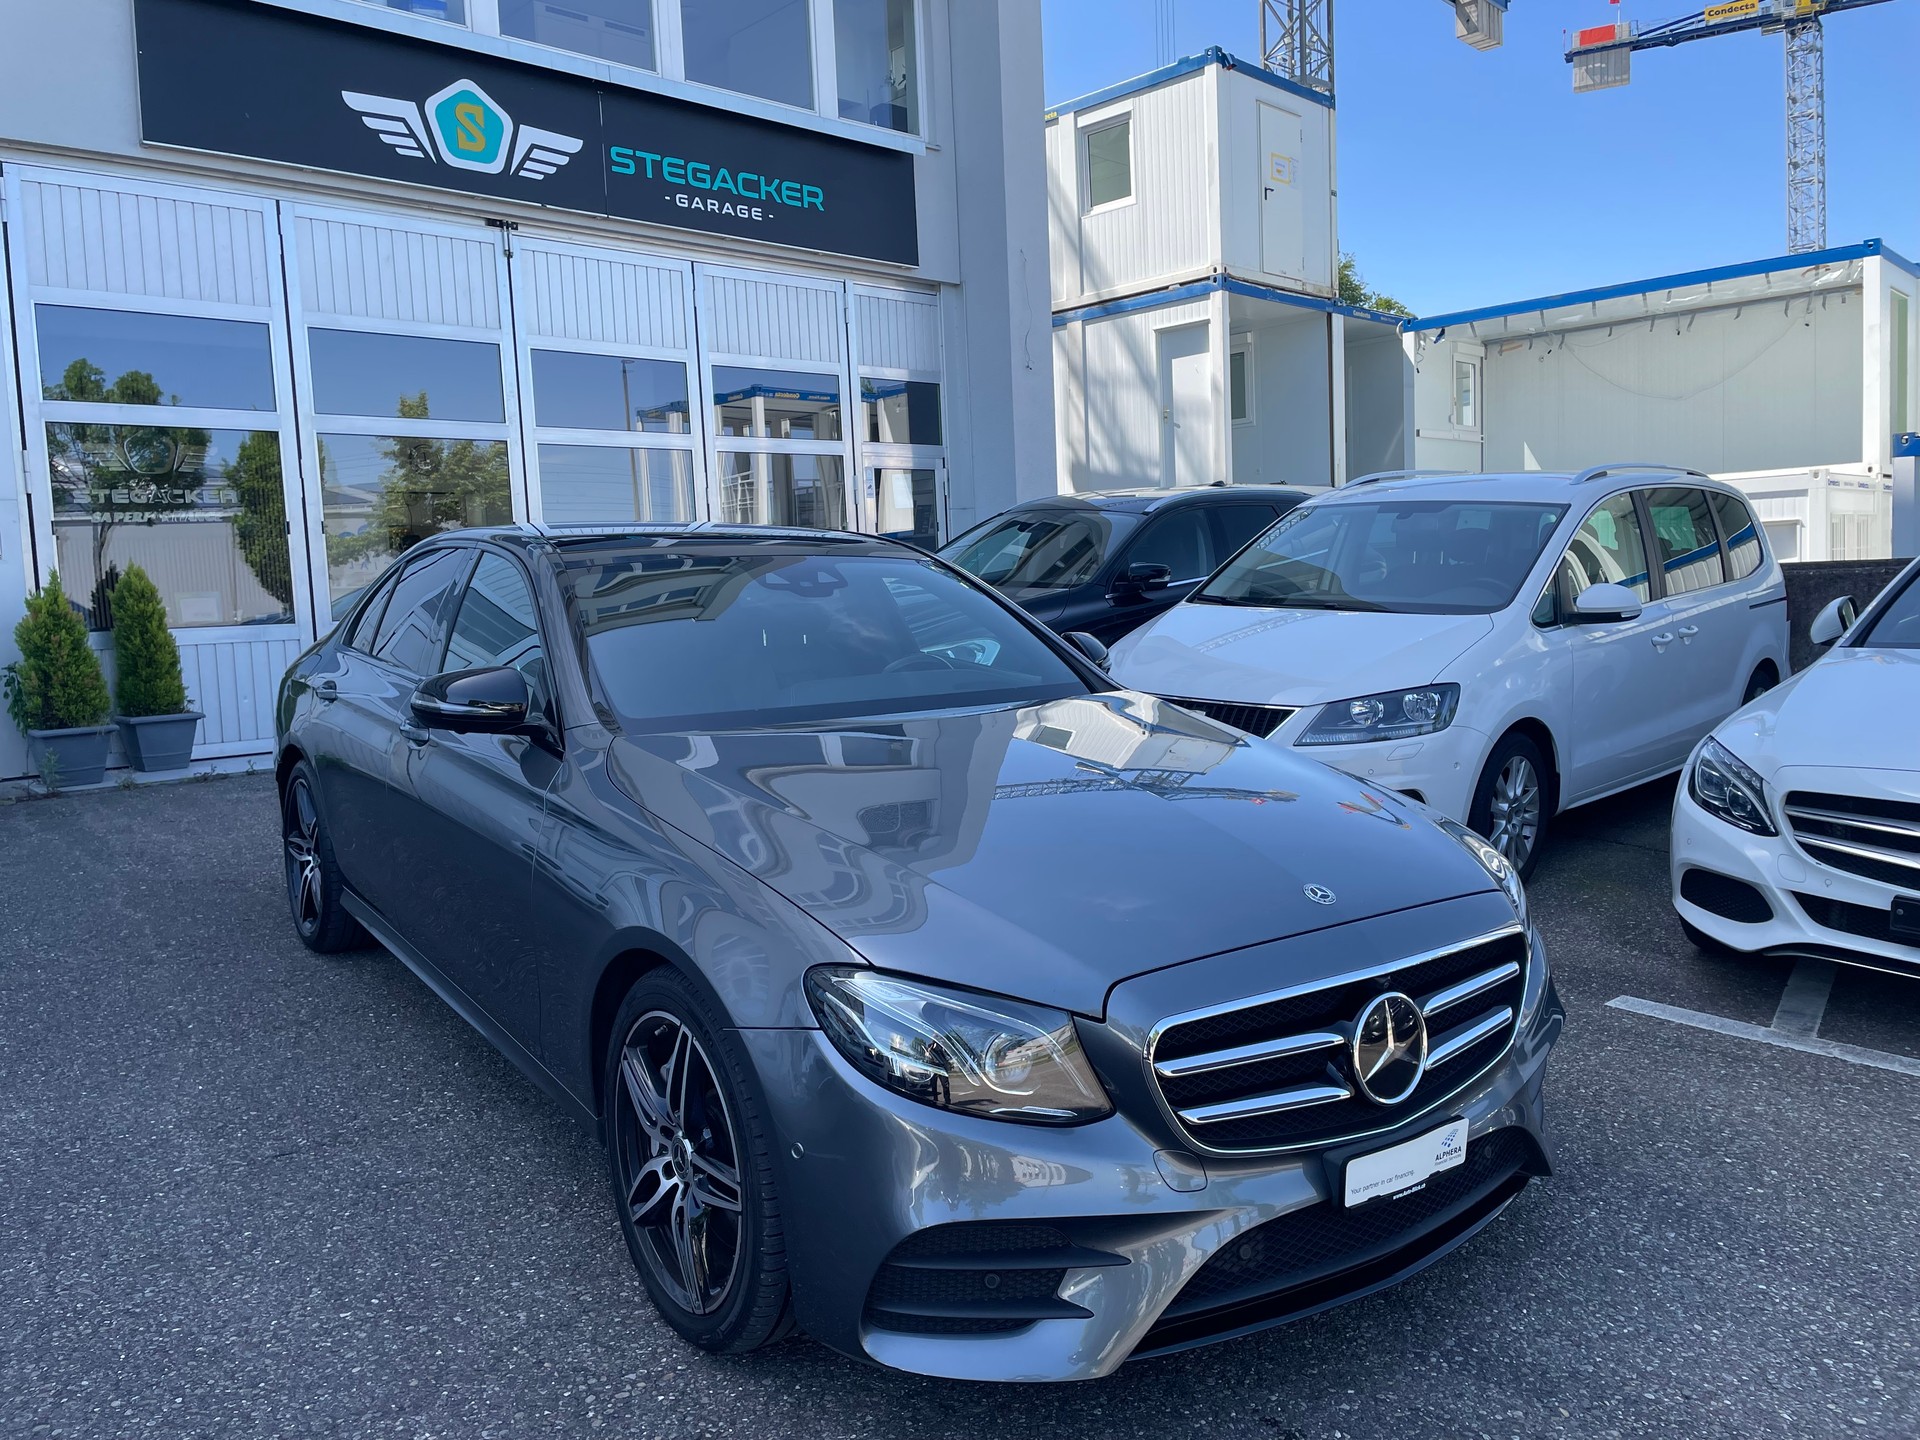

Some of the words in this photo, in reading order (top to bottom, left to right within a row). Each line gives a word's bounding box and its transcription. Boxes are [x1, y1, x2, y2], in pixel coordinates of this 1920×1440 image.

[1708, 2, 1756, 17] Condecta
[456, 104, 486, 151] S
[610, 145, 825, 212] STEGACKER
[73, 489, 238, 504] STEGACKER
[1435, 1145, 1462, 1161] ALPHERA
[1350, 1187, 1362, 1195] Your
[1362, 1181, 1380, 1192] partner
